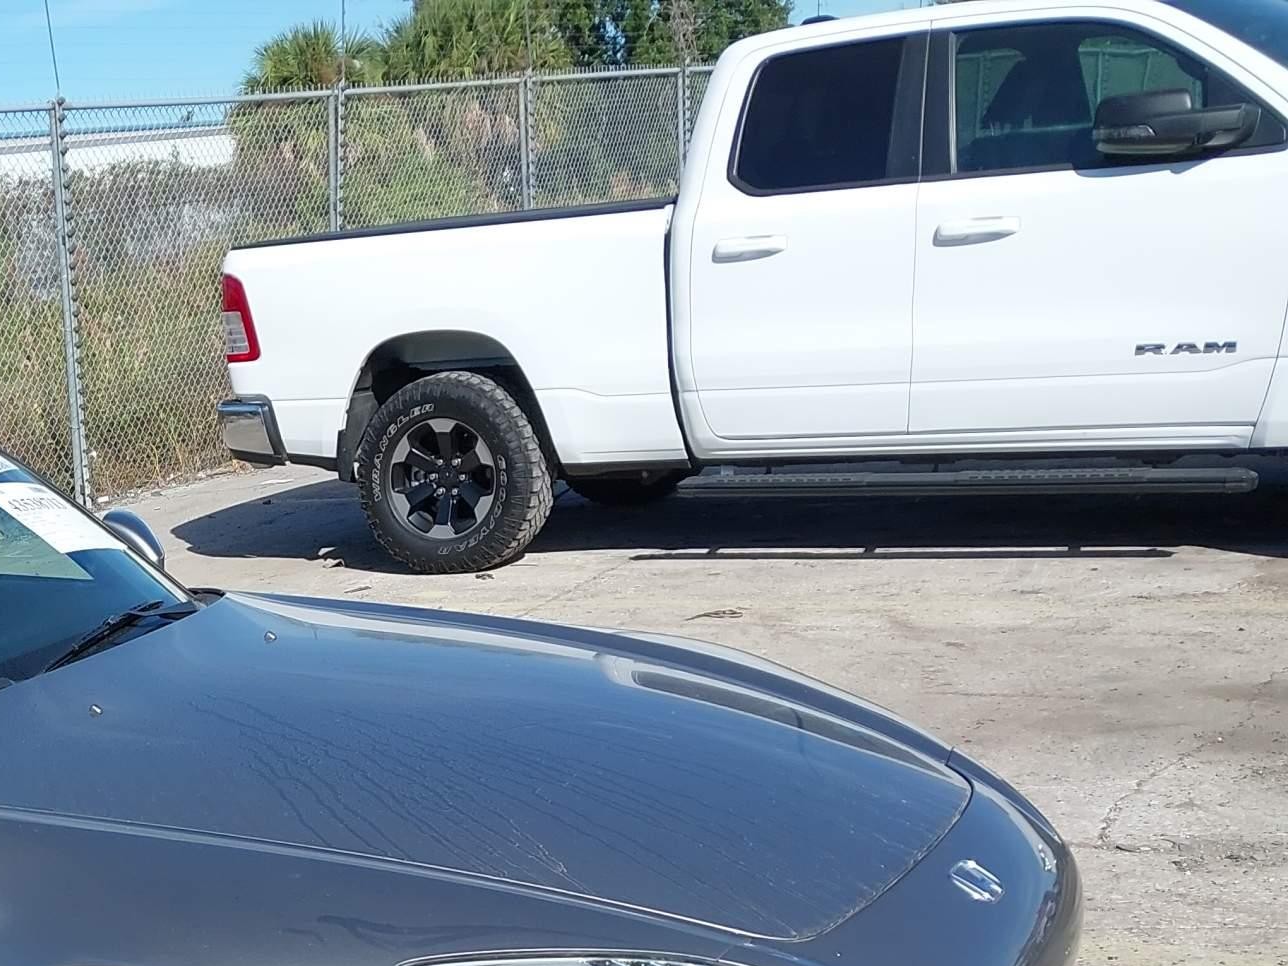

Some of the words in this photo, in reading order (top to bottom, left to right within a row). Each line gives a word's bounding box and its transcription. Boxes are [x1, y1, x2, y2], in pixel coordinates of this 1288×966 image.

[1134, 341, 1237, 356] RAM
[370, 402, 435, 503] WRANGLER
[436, 454, 509, 556] GOODYEAR
